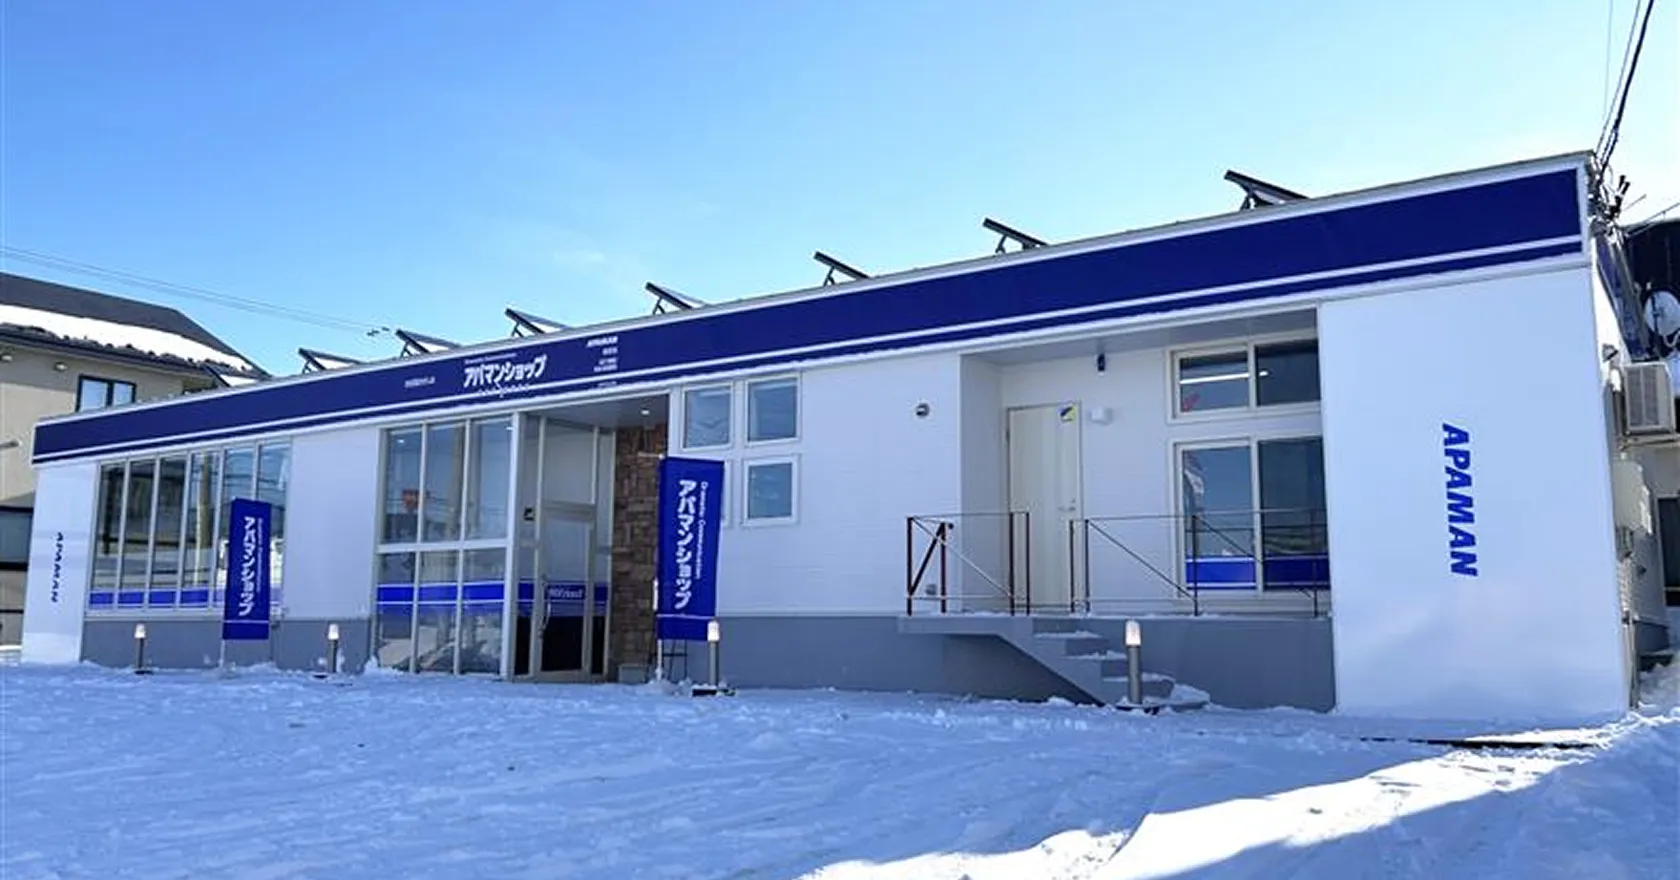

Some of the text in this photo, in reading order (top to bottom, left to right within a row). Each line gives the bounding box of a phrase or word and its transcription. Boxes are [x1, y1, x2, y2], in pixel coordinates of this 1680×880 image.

[463, 354, 547, 389] アパマンショップ
[674, 480, 697, 609] アパマンショップ
[1442, 423, 1478, 577] APAMAN
[238, 516, 256, 617] アパマンショップ
